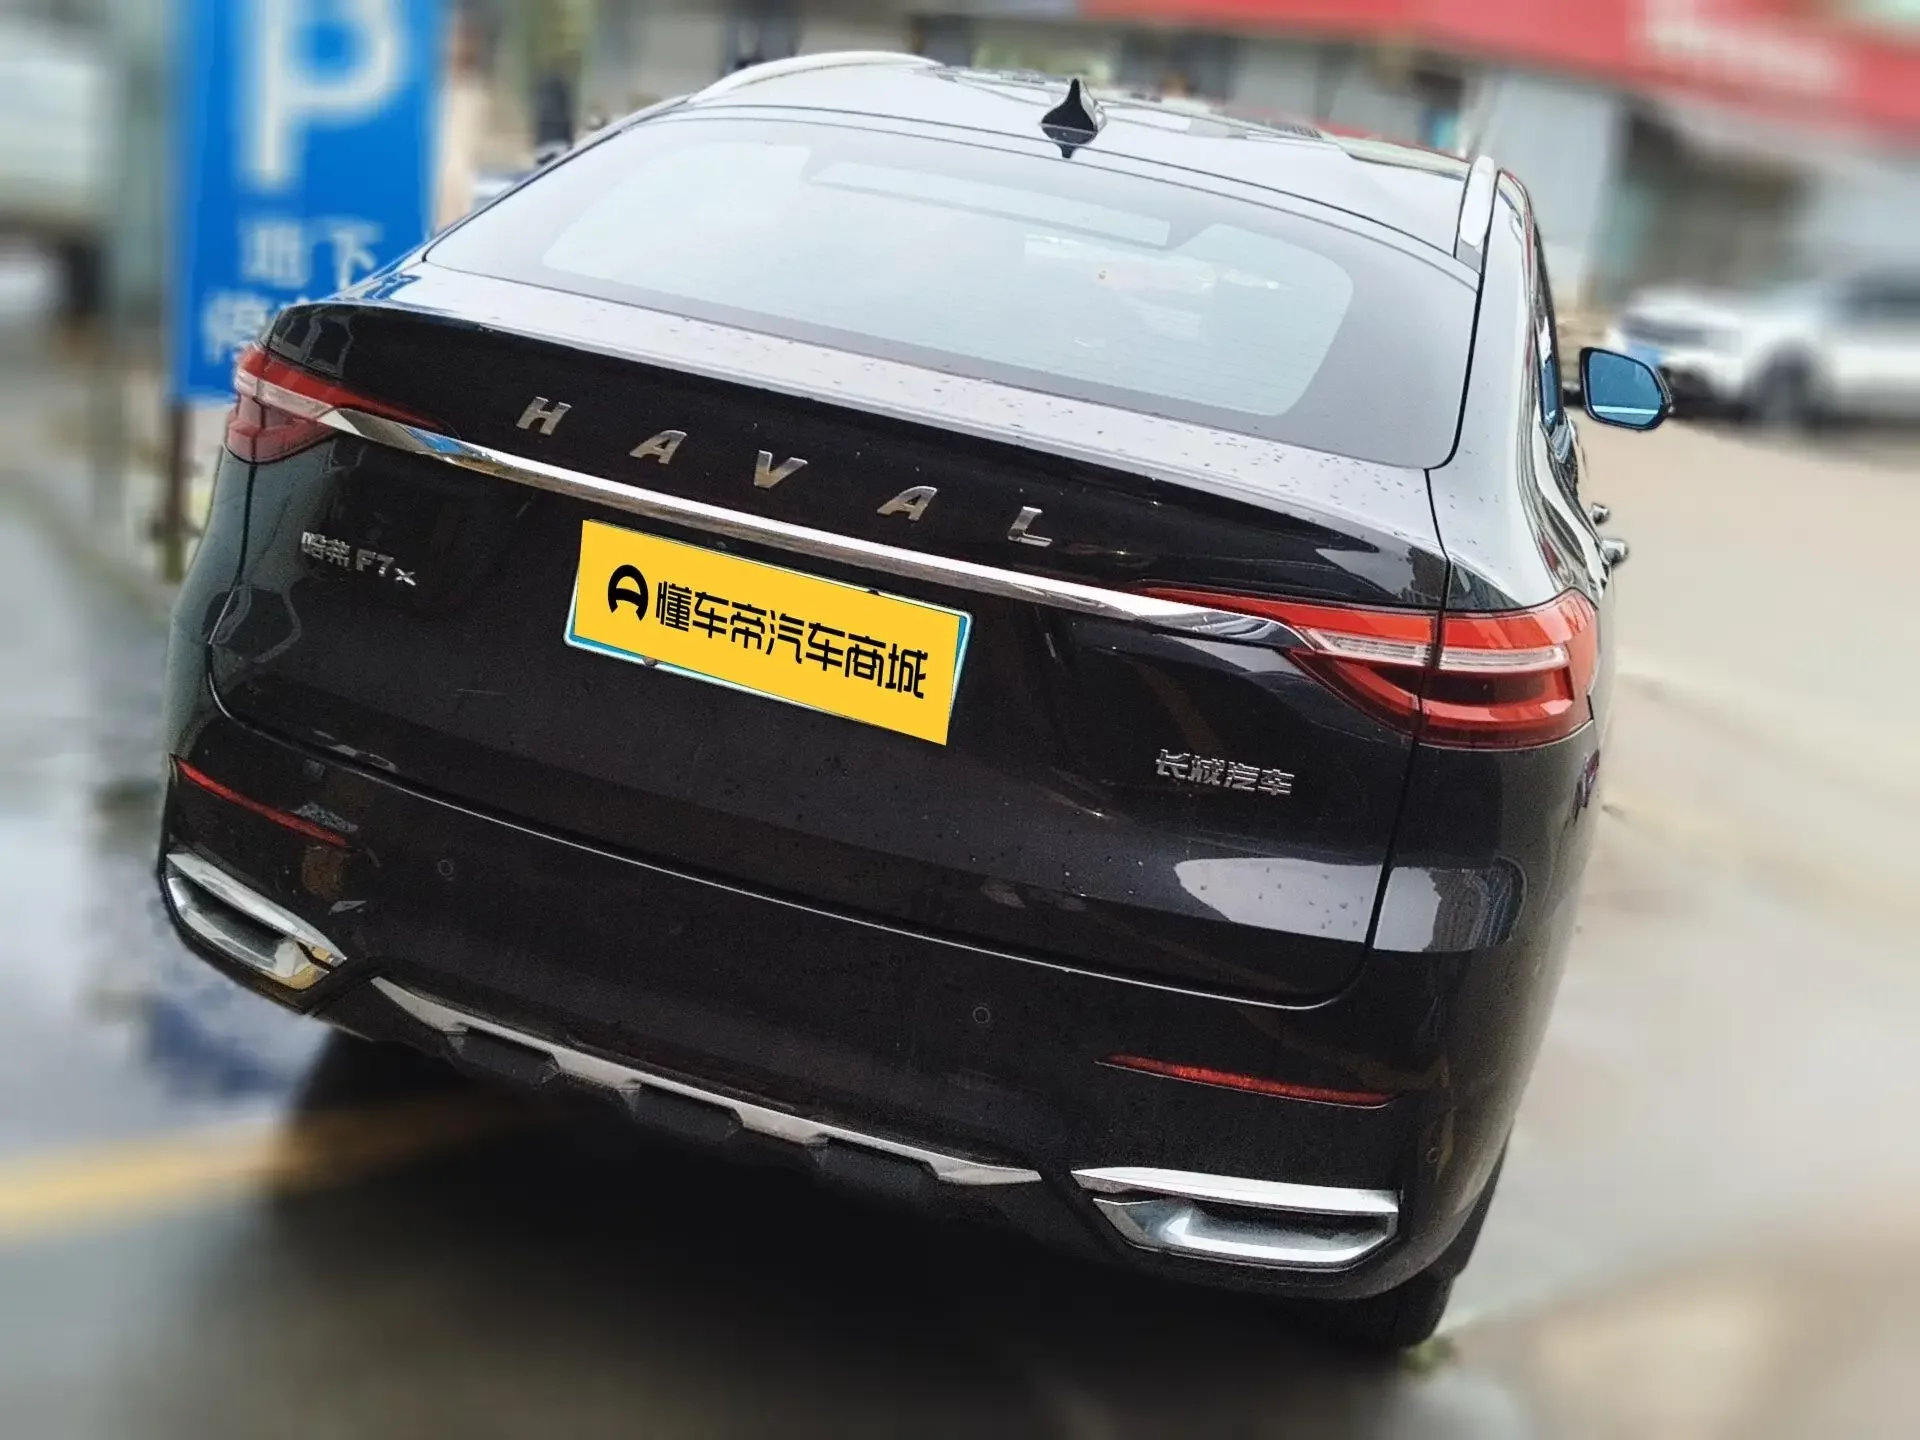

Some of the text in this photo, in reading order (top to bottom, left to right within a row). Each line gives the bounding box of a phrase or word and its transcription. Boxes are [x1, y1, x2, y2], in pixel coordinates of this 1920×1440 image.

[238, 0, 404, 188] P
[242, 217, 384, 290] 地下
[514, 396, 1053, 548] HAVAL
[1156, 749, 1295, 796] 长城汽车
